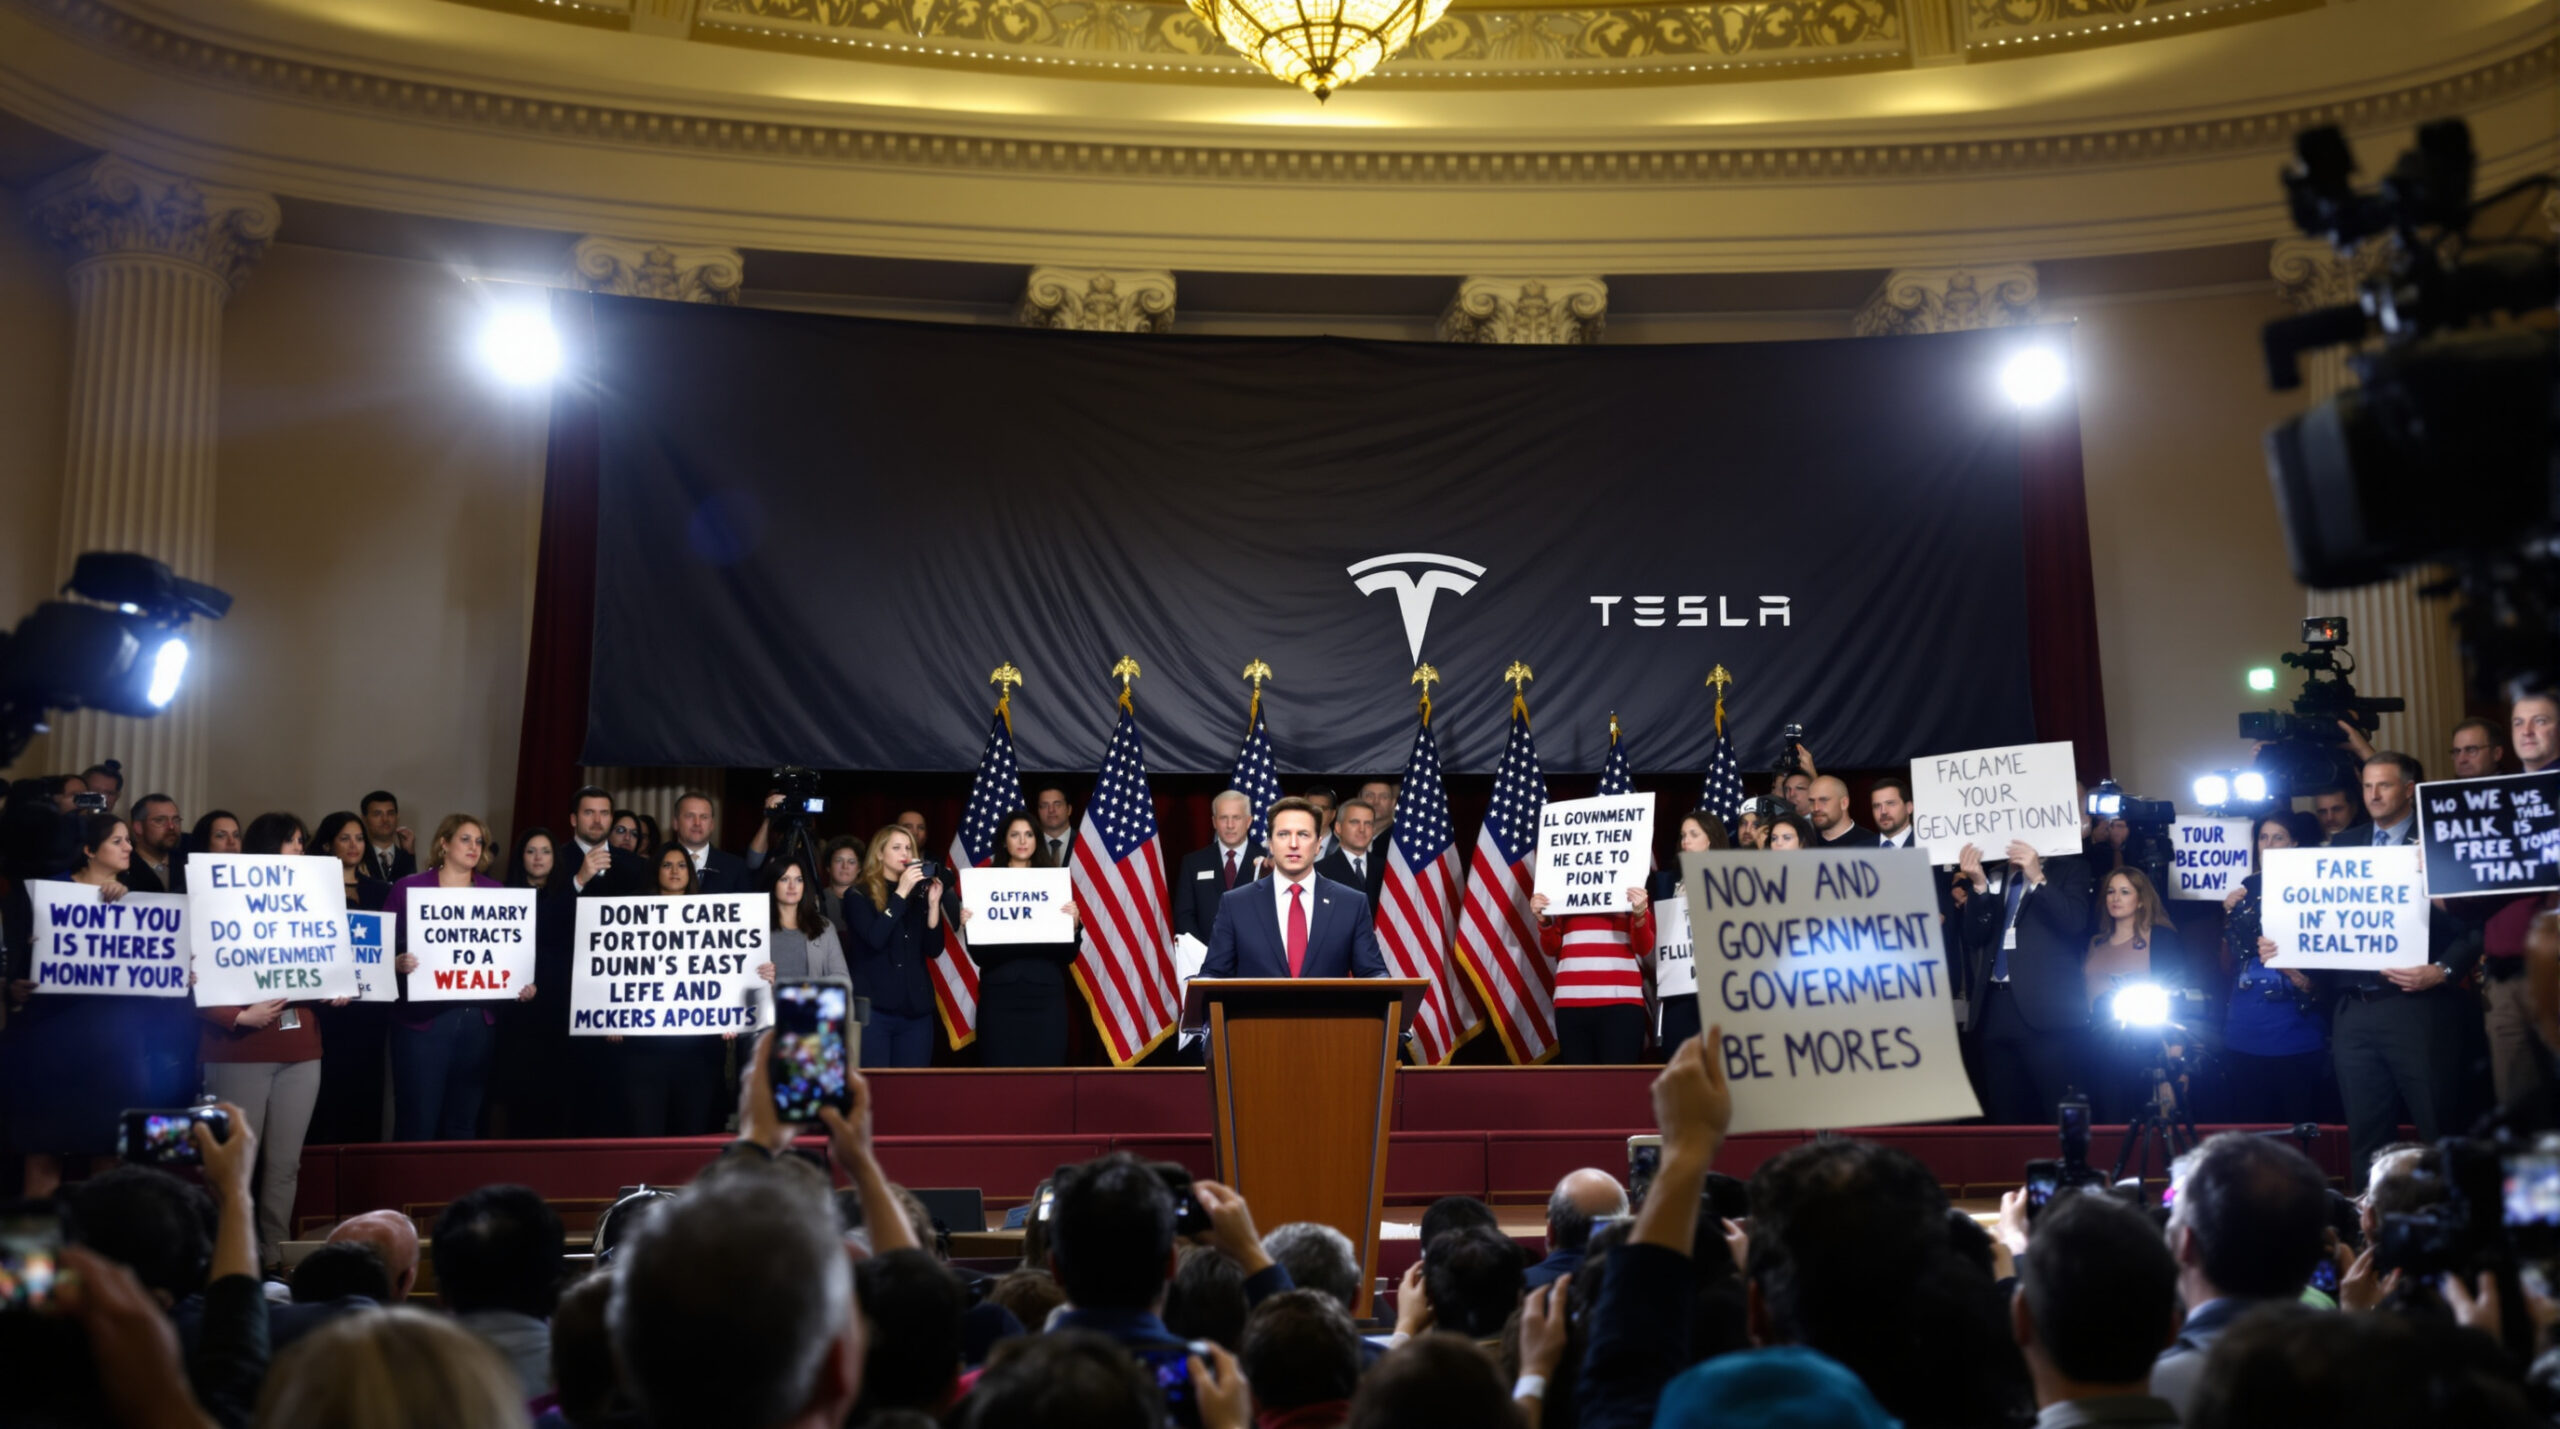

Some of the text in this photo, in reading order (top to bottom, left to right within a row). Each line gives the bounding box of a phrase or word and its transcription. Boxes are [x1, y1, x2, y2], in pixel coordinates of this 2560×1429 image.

[1590, 595, 1790, 628] TESLA
[1937, 752, 2027, 783] FACAME
[1958, 783, 2017, 807] YOUR
[2463, 789, 2501, 810] WE
[1595, 829, 1632, 844] THEN
[2182, 826, 2225, 843] TOUR
[2434, 817, 2532, 842] BALK IS
[1554, 850, 1629, 867] HE CAE TO
[2176, 850, 2247, 868] BECOUM
[2454, 839, 2513, 860] FREE
[2317, 859, 2373, 879] FARE
[2470, 860, 2539, 881] THAT
[1703, 861, 1880, 911] NOW AND
[246, 893, 308, 913] WUSK
[1566, 892, 1612, 907] MAKE
[50, 903, 181, 932] WON'T YOU
[420, 904, 528, 920] ELON MARRY
[600, 903, 741, 926] DON'T CARE
[988, 906, 1032, 920] OLVR
[2336, 910, 2395, 929] YOUR
[211, 921, 337, 941] DO OF THES
[424, 928, 522, 943] CONTRACTS
[590, 929, 762, 951] FORTONTANCS
[1719, 912, 1930, 961] GOVERNMENT
[54, 933, 175, 959] IS THERES
[2299, 933, 2398, 953] REALTHD
[453, 949, 494, 965] FO A
[591, 954, 747, 976] DUNN'S EASY
[40, 962, 184, 988] MONNT YOUR
[254, 968, 322, 989] WFERS
[434, 970, 511, 990] WEAL?
[610, 980, 721, 1003] LEFE AND
[1721, 960, 1939, 1012] GOVERMENT
[574, 1006, 757, 1028] MCKERS APOEUTS
[1722, 1026, 1921, 1081] BE MORES
